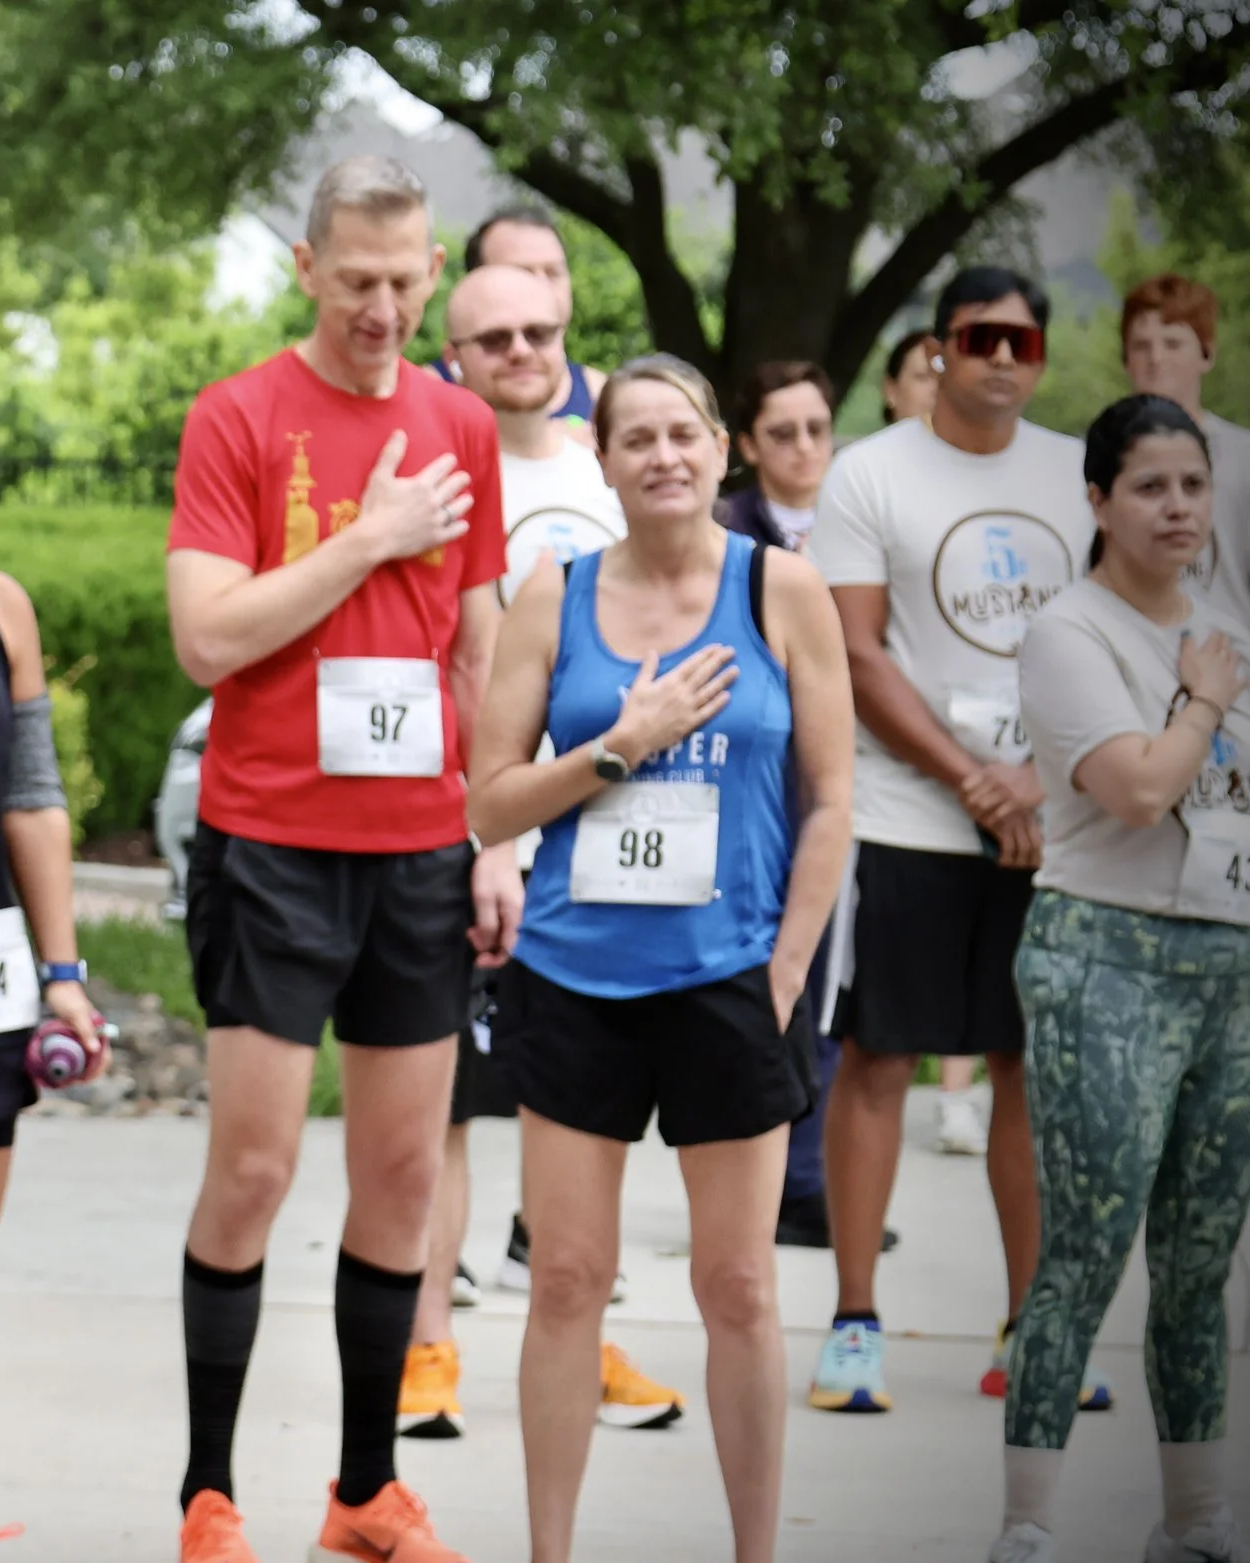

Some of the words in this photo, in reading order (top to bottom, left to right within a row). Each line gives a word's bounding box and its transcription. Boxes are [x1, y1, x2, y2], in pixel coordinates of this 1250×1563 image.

[370, 704, 408, 742] 97
[619, 828, 663, 868] 98
[1226, 855, 1250, 890] 4
